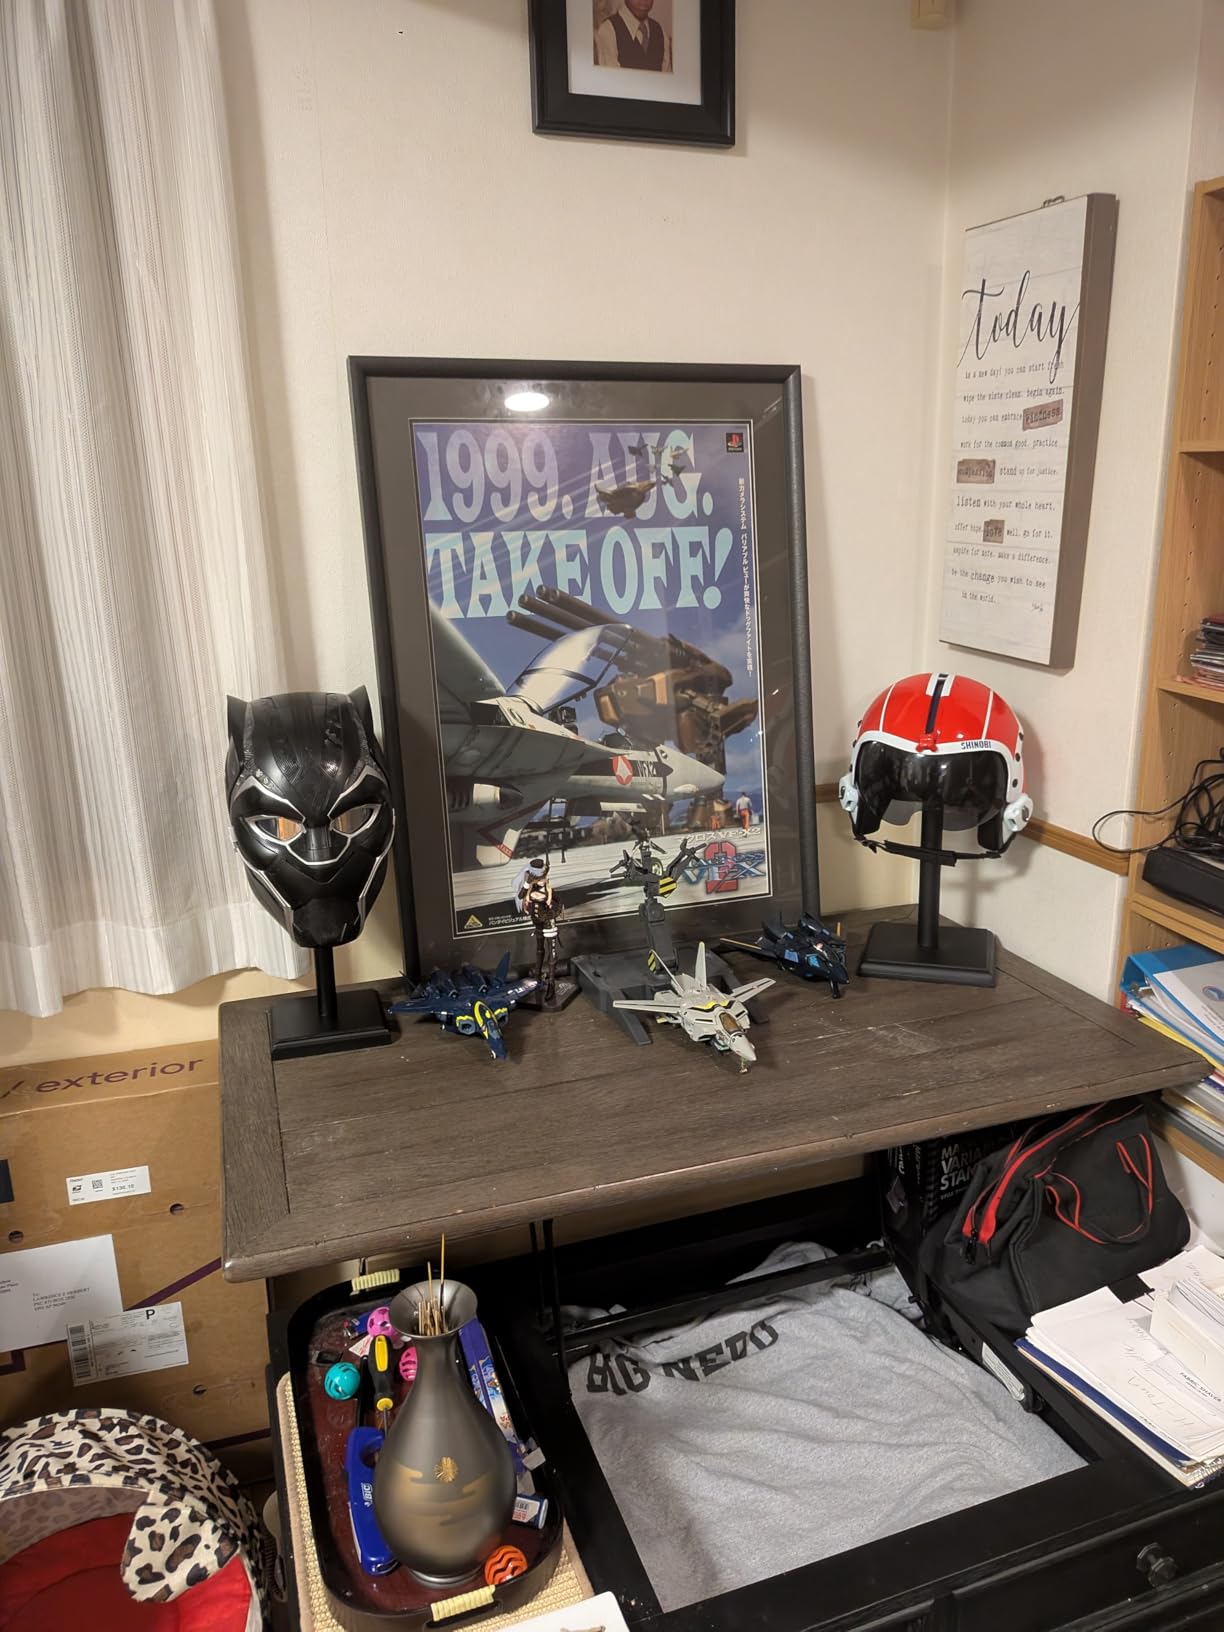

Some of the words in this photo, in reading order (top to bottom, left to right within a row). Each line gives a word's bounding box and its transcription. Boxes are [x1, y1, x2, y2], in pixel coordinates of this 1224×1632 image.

[957, 270, 1080, 385] today
[1004, 367, 1014, 376] you
[1029, 363, 1044, 372] start
[977, 392, 986, 400] the
[978, 415, 987, 424] you
[960, 440, 971, 448] work
[973, 440, 982, 449] for
[984, 440, 992, 448] the
[416, 429, 573, 523] 1999.
[585, 429, 714, 520] AUG.
[1000, 467, 1016, 476] stand
[1027, 467, 1036, 476] for
[957, 496, 981, 508] listen
[983, 498, 996, 508] with
[998, 501, 1012, 510] your
[1015, 501, 1032, 510] whole
[986, 523, 1002, 538] love
[1032, 529, 1042, 538] for
[971, 547, 980, 556] for
[425, 529, 592, 619] TAKE
[600, 526, 733, 615] OFF!
[960, 568, 968, 578] the
[970, 571, 995, 584] change
[997, 576, 1008, 584] you
[1010, 576, 1024, 584] wish
[1026, 578, 1033, 587] to
[1035, 580, 1046, 589] see
[970, 592, 978, 600] the
[960, 741, 992, 750] SHINOBI
[36, 1057, 204, 1093] exterior
[145, 1309, 155, 1320] P
[361, 1482, 373, 1501] BIC
